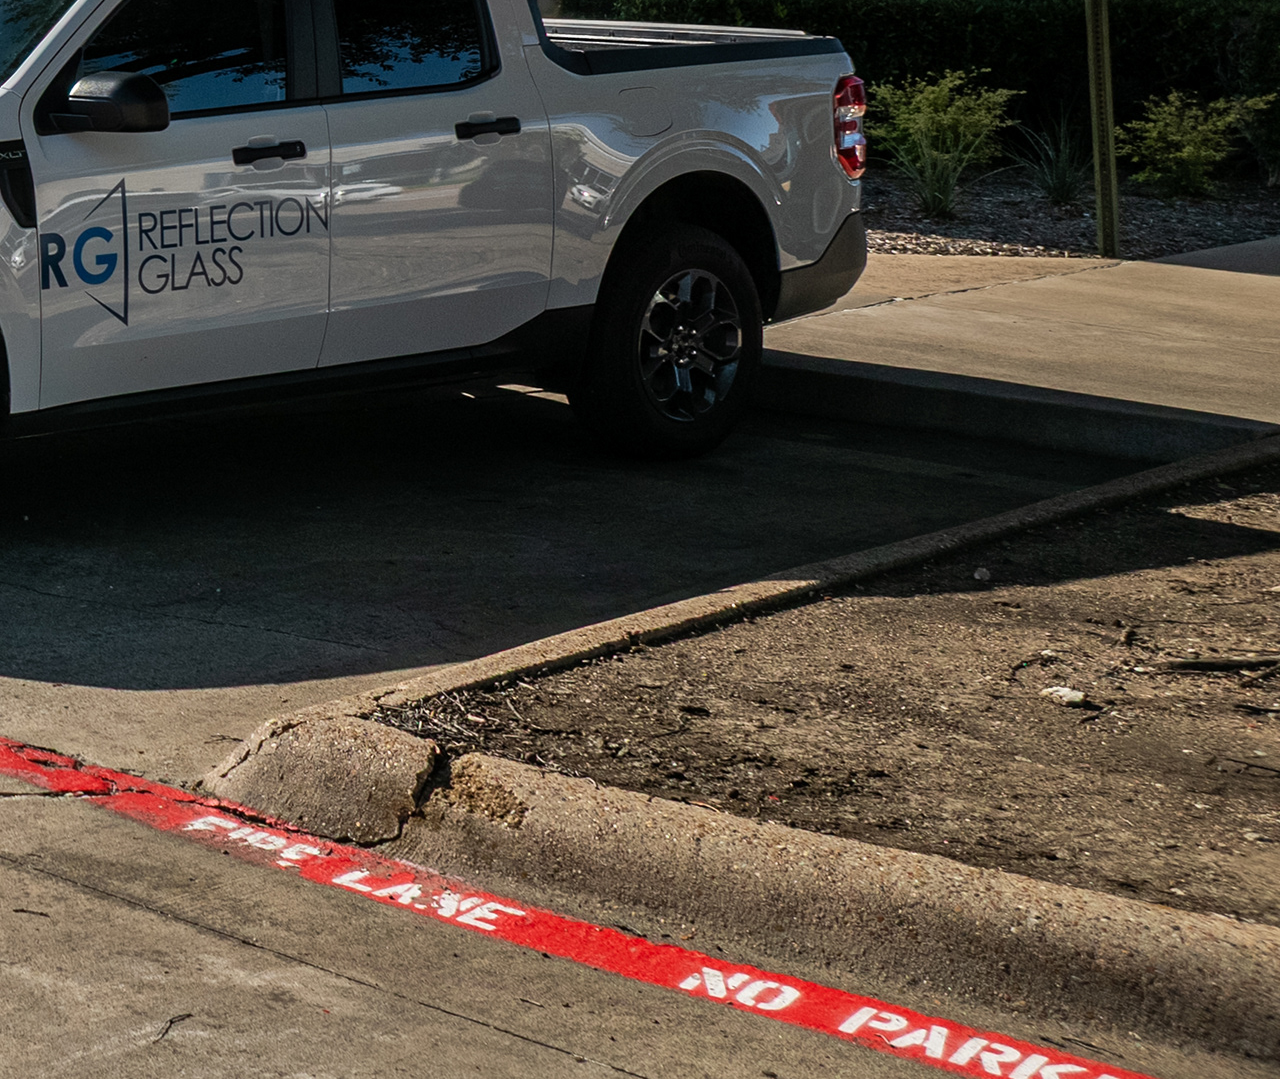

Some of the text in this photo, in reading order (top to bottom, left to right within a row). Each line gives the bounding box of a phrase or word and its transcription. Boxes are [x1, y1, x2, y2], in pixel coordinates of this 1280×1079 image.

[138, 196, 329, 251] REFLECTION
[39, 226, 118, 290] RG
[137, 246, 244, 295] GLASS
[332, 868, 527, 931] LANE
[679, 967, 1147, 1079] NO PARK
